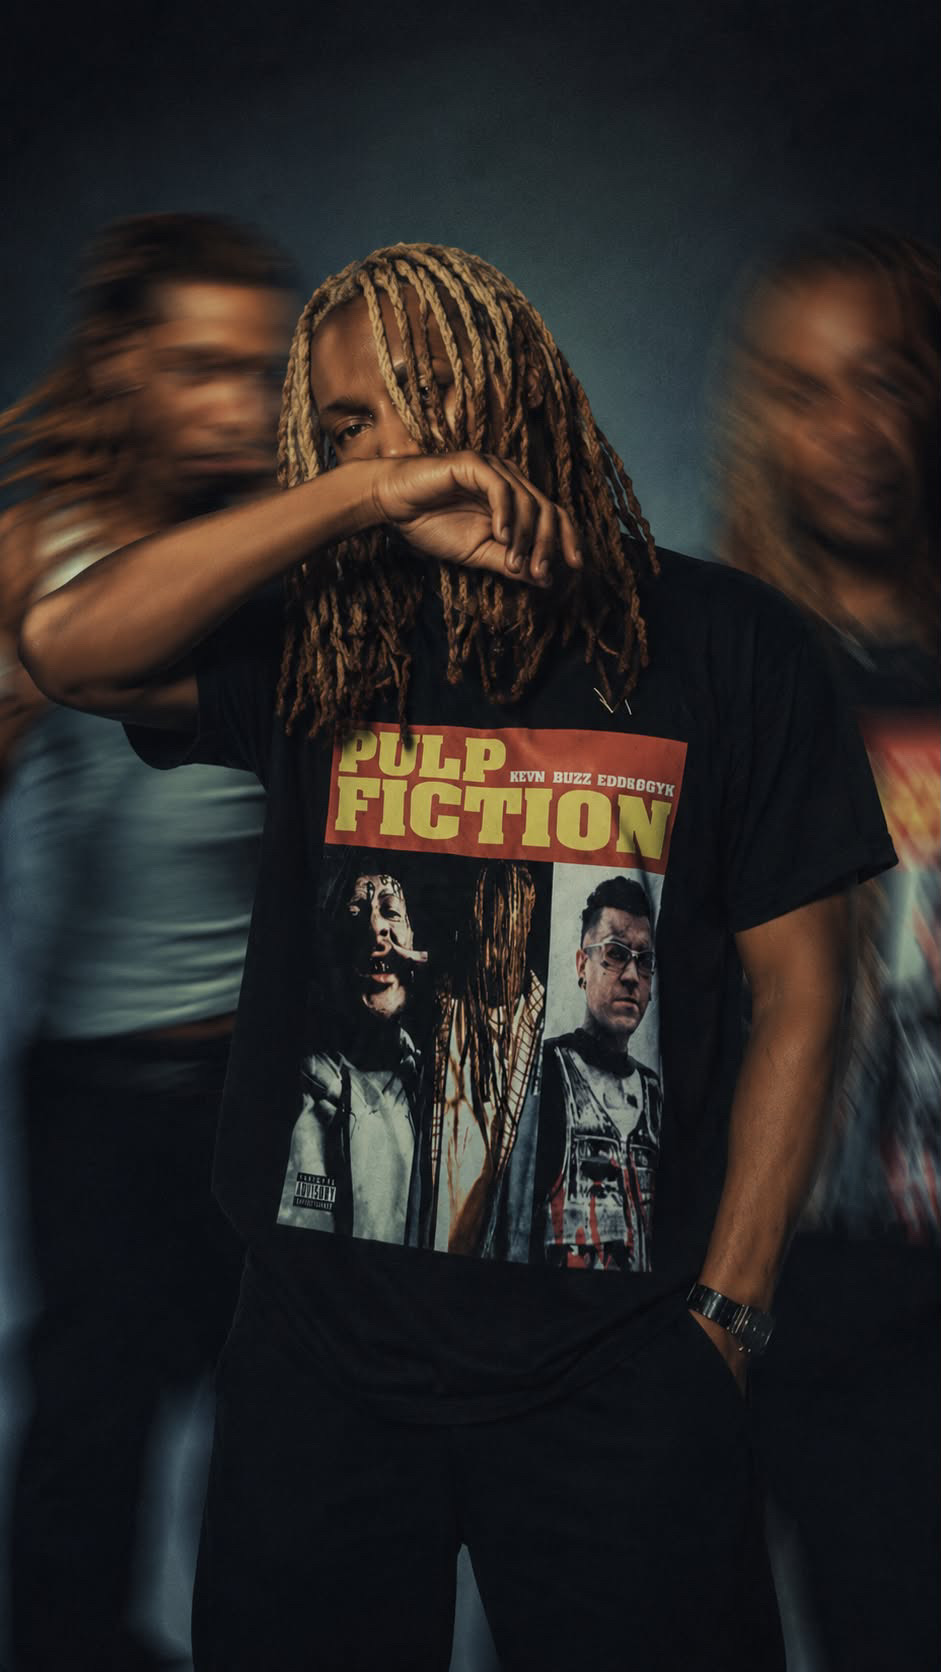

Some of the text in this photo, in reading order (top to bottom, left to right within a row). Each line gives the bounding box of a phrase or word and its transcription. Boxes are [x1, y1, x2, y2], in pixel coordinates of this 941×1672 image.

[338, 730, 507, 782] PULP
[510, 770, 545, 783] KEVN
[552, 771, 592, 785] BUZZ
[335, 776, 673, 859] FICTION
